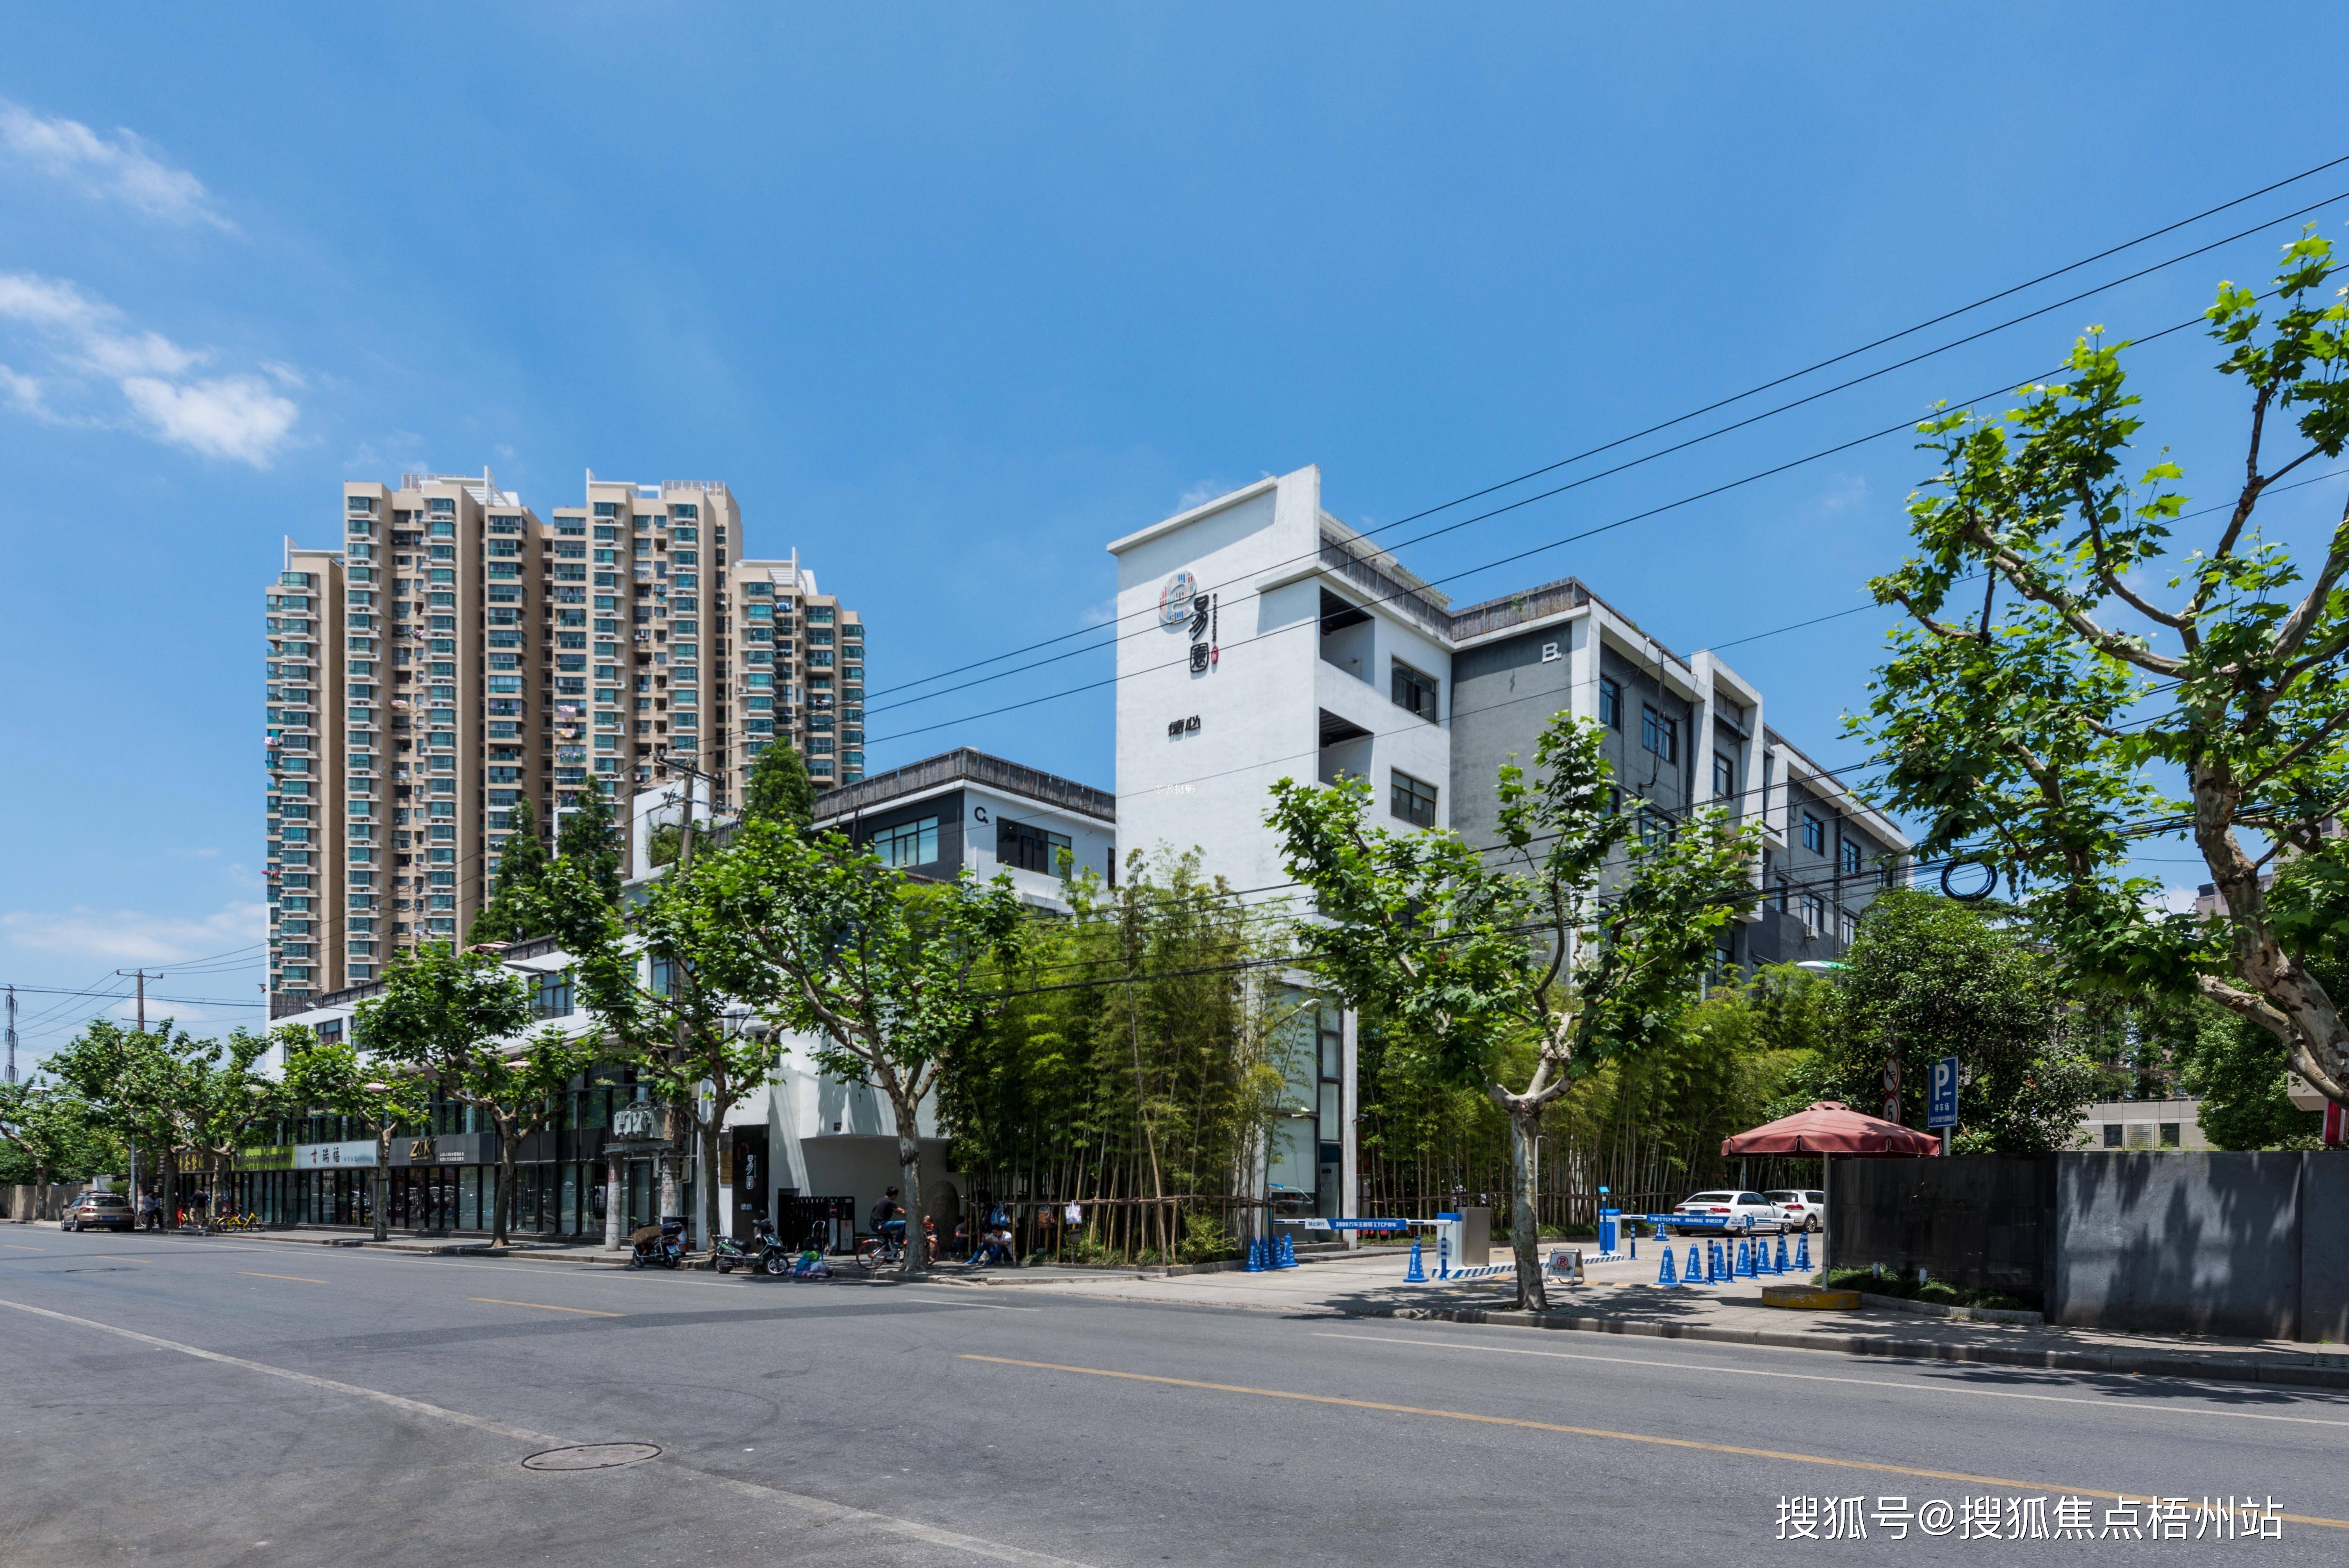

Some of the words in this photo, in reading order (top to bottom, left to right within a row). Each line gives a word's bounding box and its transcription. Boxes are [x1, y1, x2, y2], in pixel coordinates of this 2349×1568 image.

[1168, 715, 1201, 737] 德必
[1935, 1064, 1949, 1101] P
[1888, 1105, 1893, 1122] 5
[1935, 1102, 1950, 1112] 停车场
